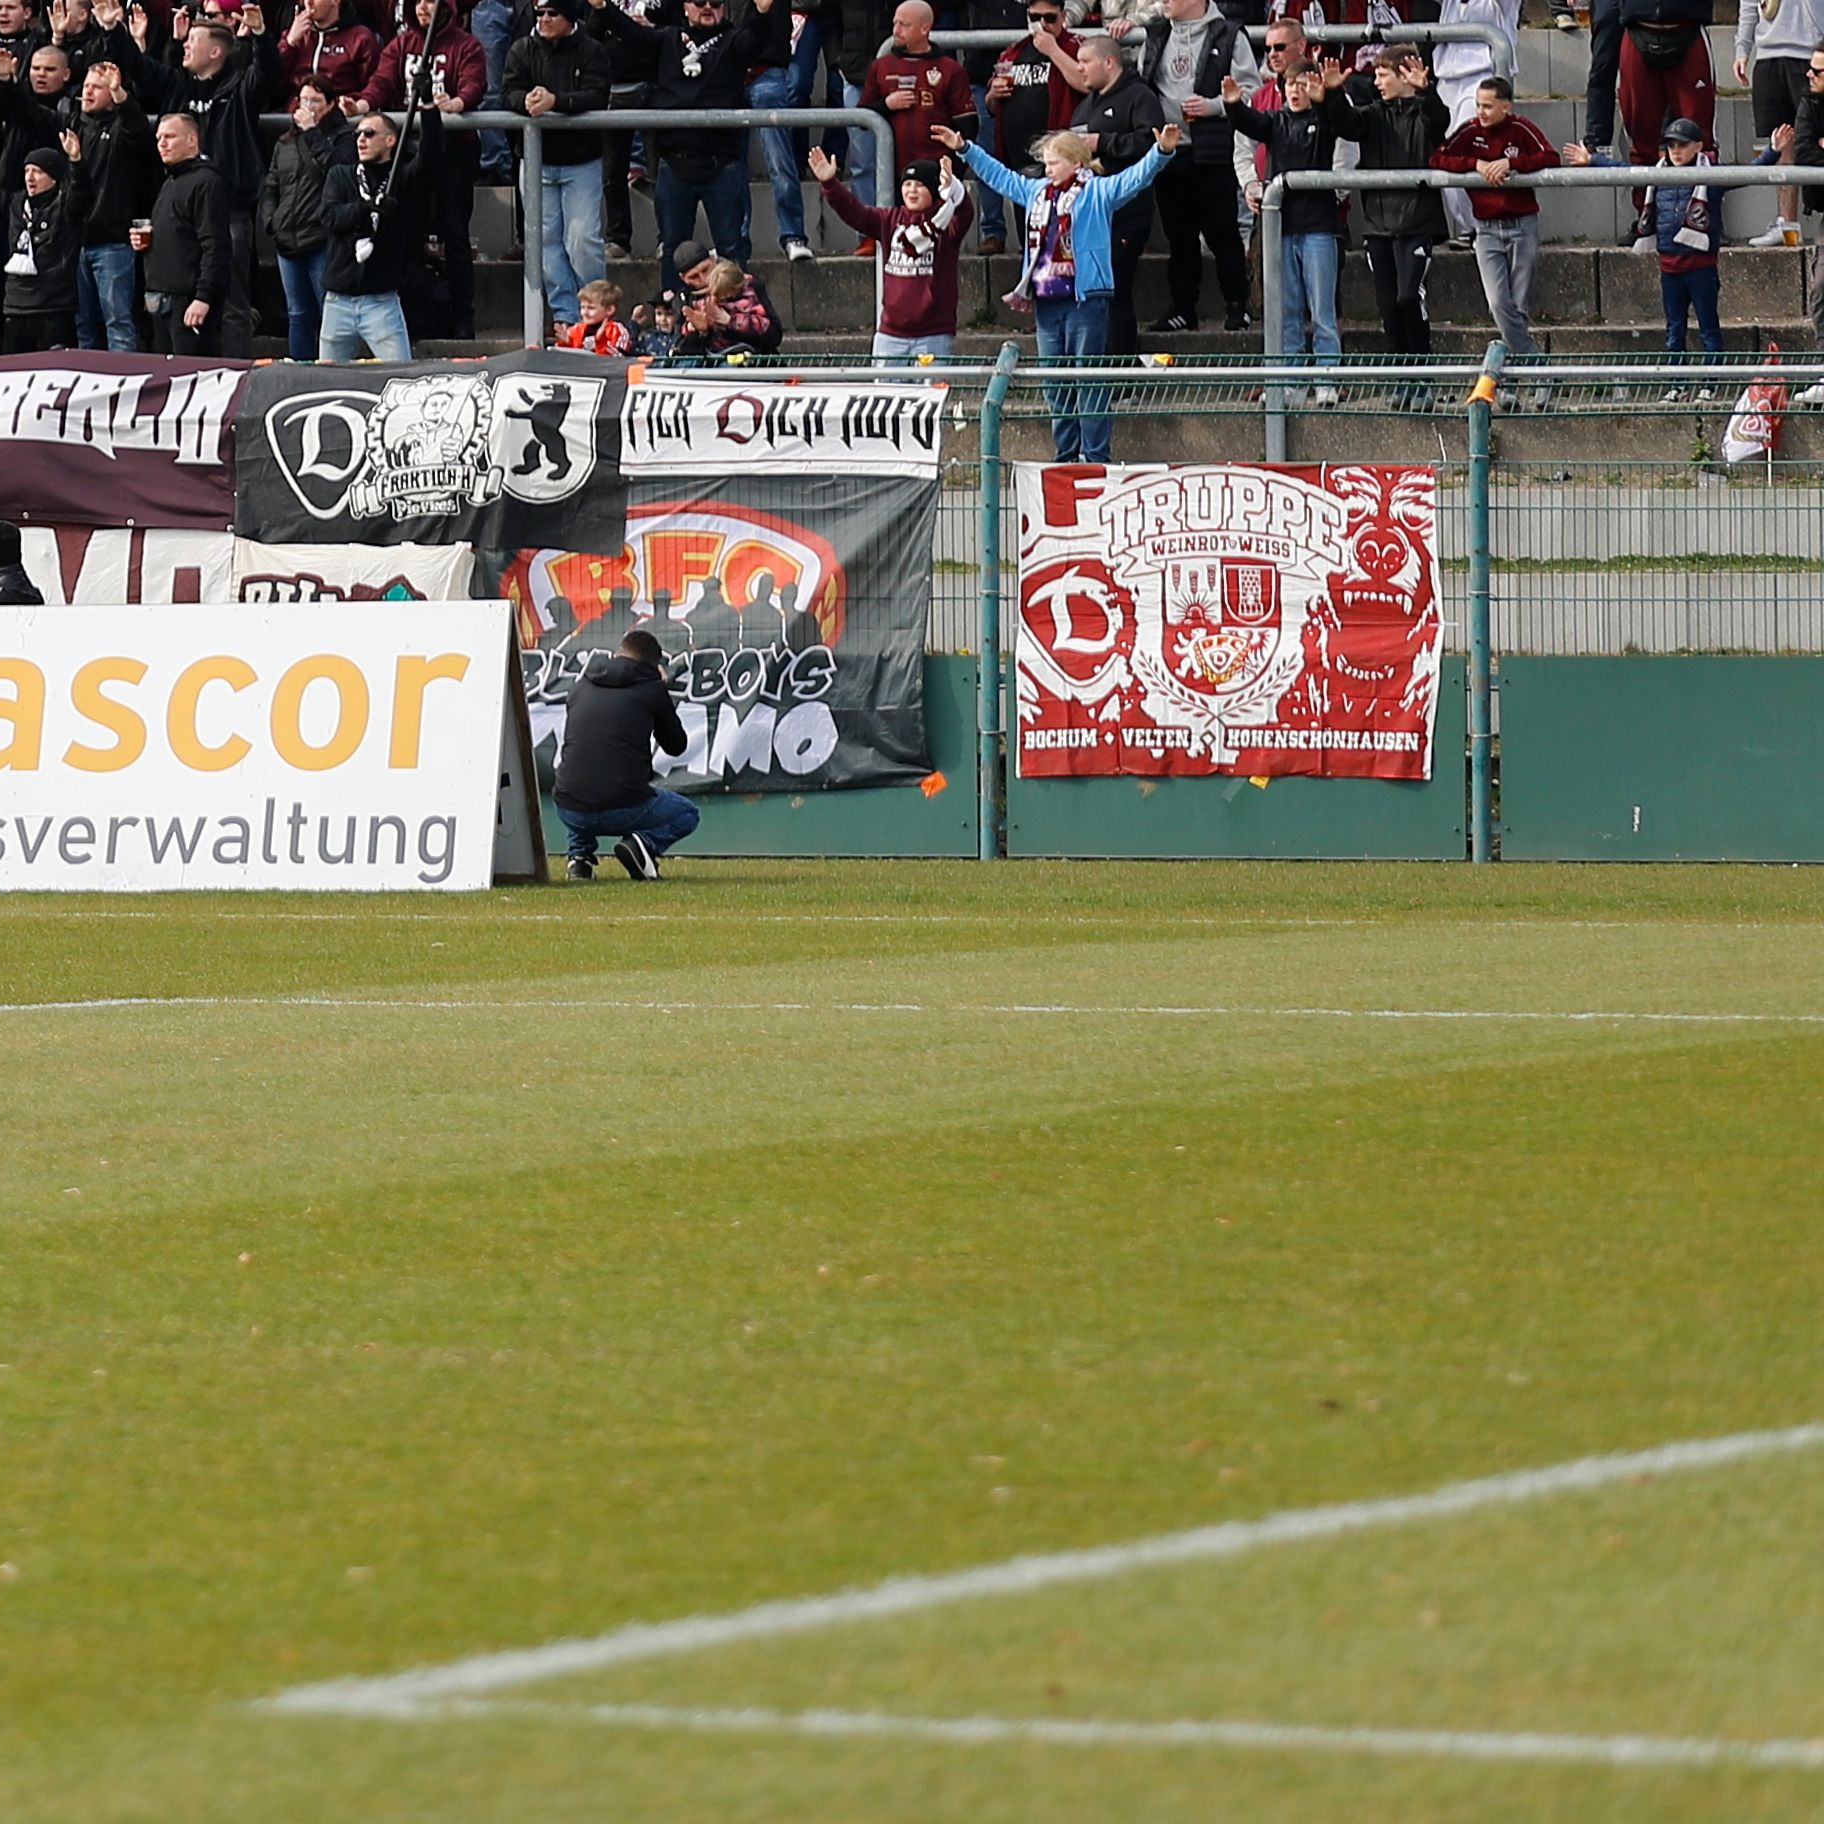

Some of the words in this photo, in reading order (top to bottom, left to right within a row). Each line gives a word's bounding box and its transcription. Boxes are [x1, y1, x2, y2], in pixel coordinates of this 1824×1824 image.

[629, 390, 695, 454] FICK
[1101, 474, 1343, 566] TRUPPE
[1152, 535, 1228, 557] WEINROT
[1238, 538, 1291, 558] WEISS
[548, 528, 805, 622] BFC
[1024, 727, 1098, 750] BOCHUM
[1121, 727, 1192, 751] VELTEN
[1225, 725, 1420, 752] HOHENSCHÖNHAUSEN
